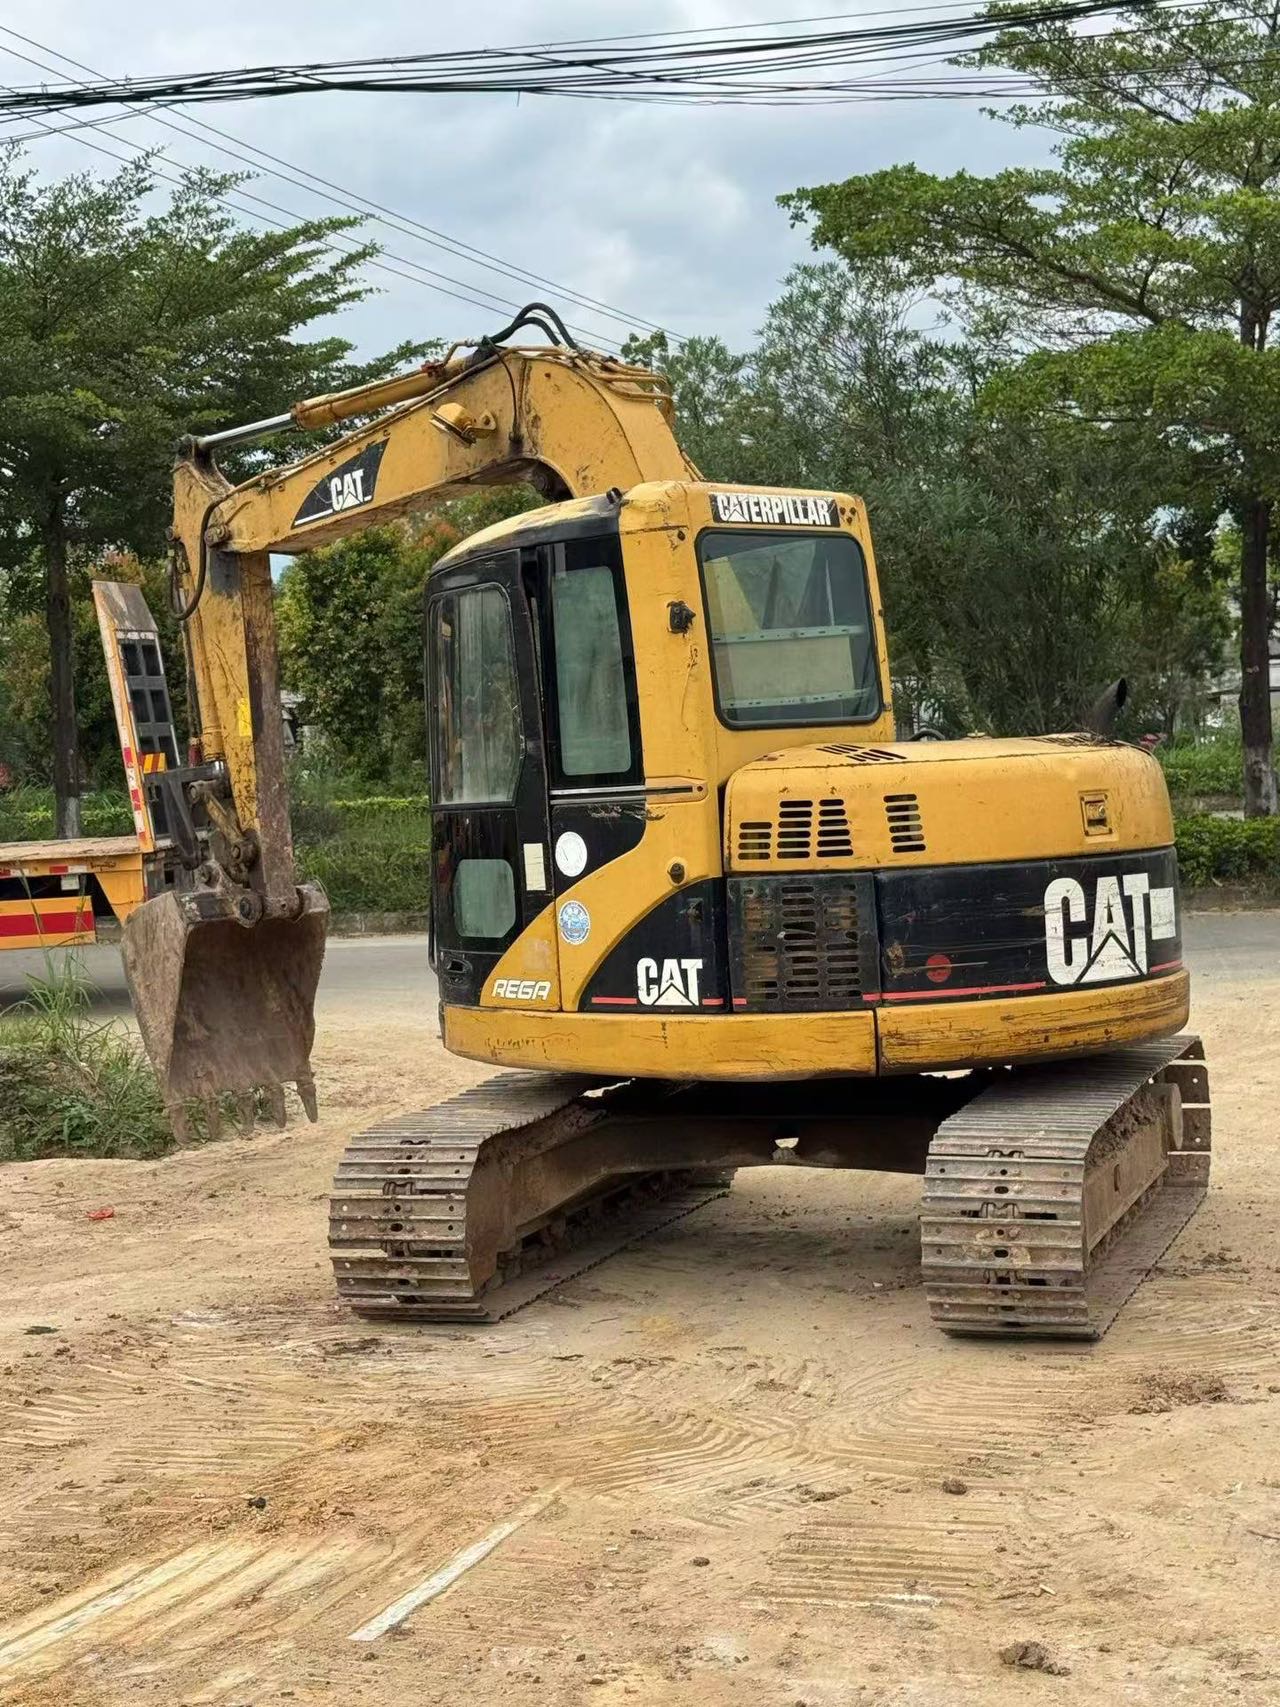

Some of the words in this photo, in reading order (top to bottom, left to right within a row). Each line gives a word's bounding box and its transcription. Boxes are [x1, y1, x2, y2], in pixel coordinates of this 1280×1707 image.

[330, 468, 365, 511] CAT
[716, 494, 832, 526] CATERPILLAR
[1044, 872, 1148, 986] CAT
[491, 979, 551, 1001] REGA
[636, 957, 703, 1006] CAT
